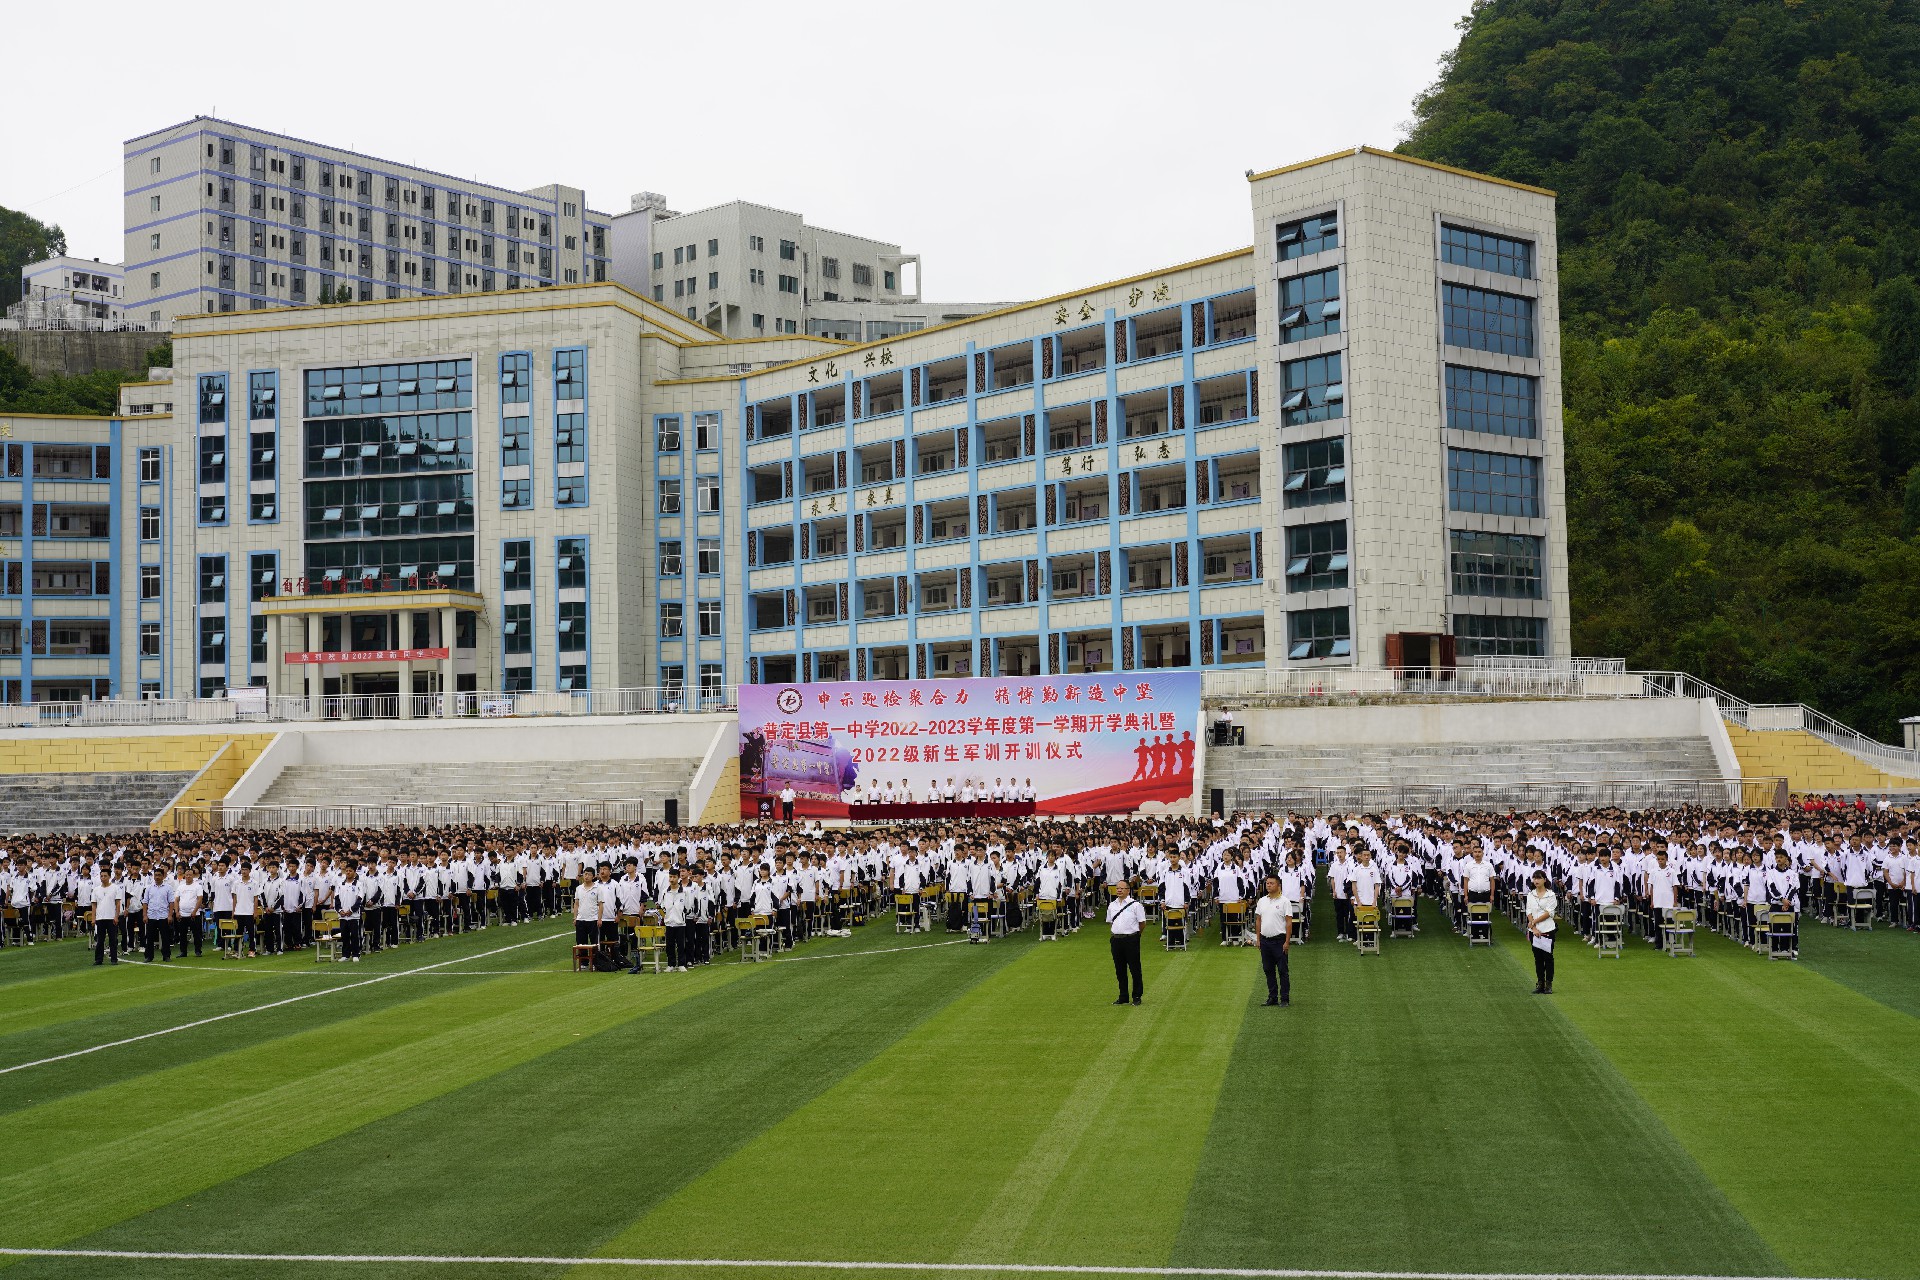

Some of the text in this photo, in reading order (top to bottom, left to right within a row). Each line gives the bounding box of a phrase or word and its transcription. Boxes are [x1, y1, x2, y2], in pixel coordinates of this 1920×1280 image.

[1054, 299, 1095, 325] 安全
[808, 347, 894, 383] 文化 兴校
[1061, 455, 1095, 475] 笃行
[811, 486, 894, 517] 求是 求真
[818, 682, 1154, 710] 申示迎检聚合力 精博勤新造中坚
[763, 712, 1176, 741] 普定县第一中学2022-2023学年度第一学期开学典礼暨
[852, 741, 1083, 763] 2022级新生军训开训仪式
